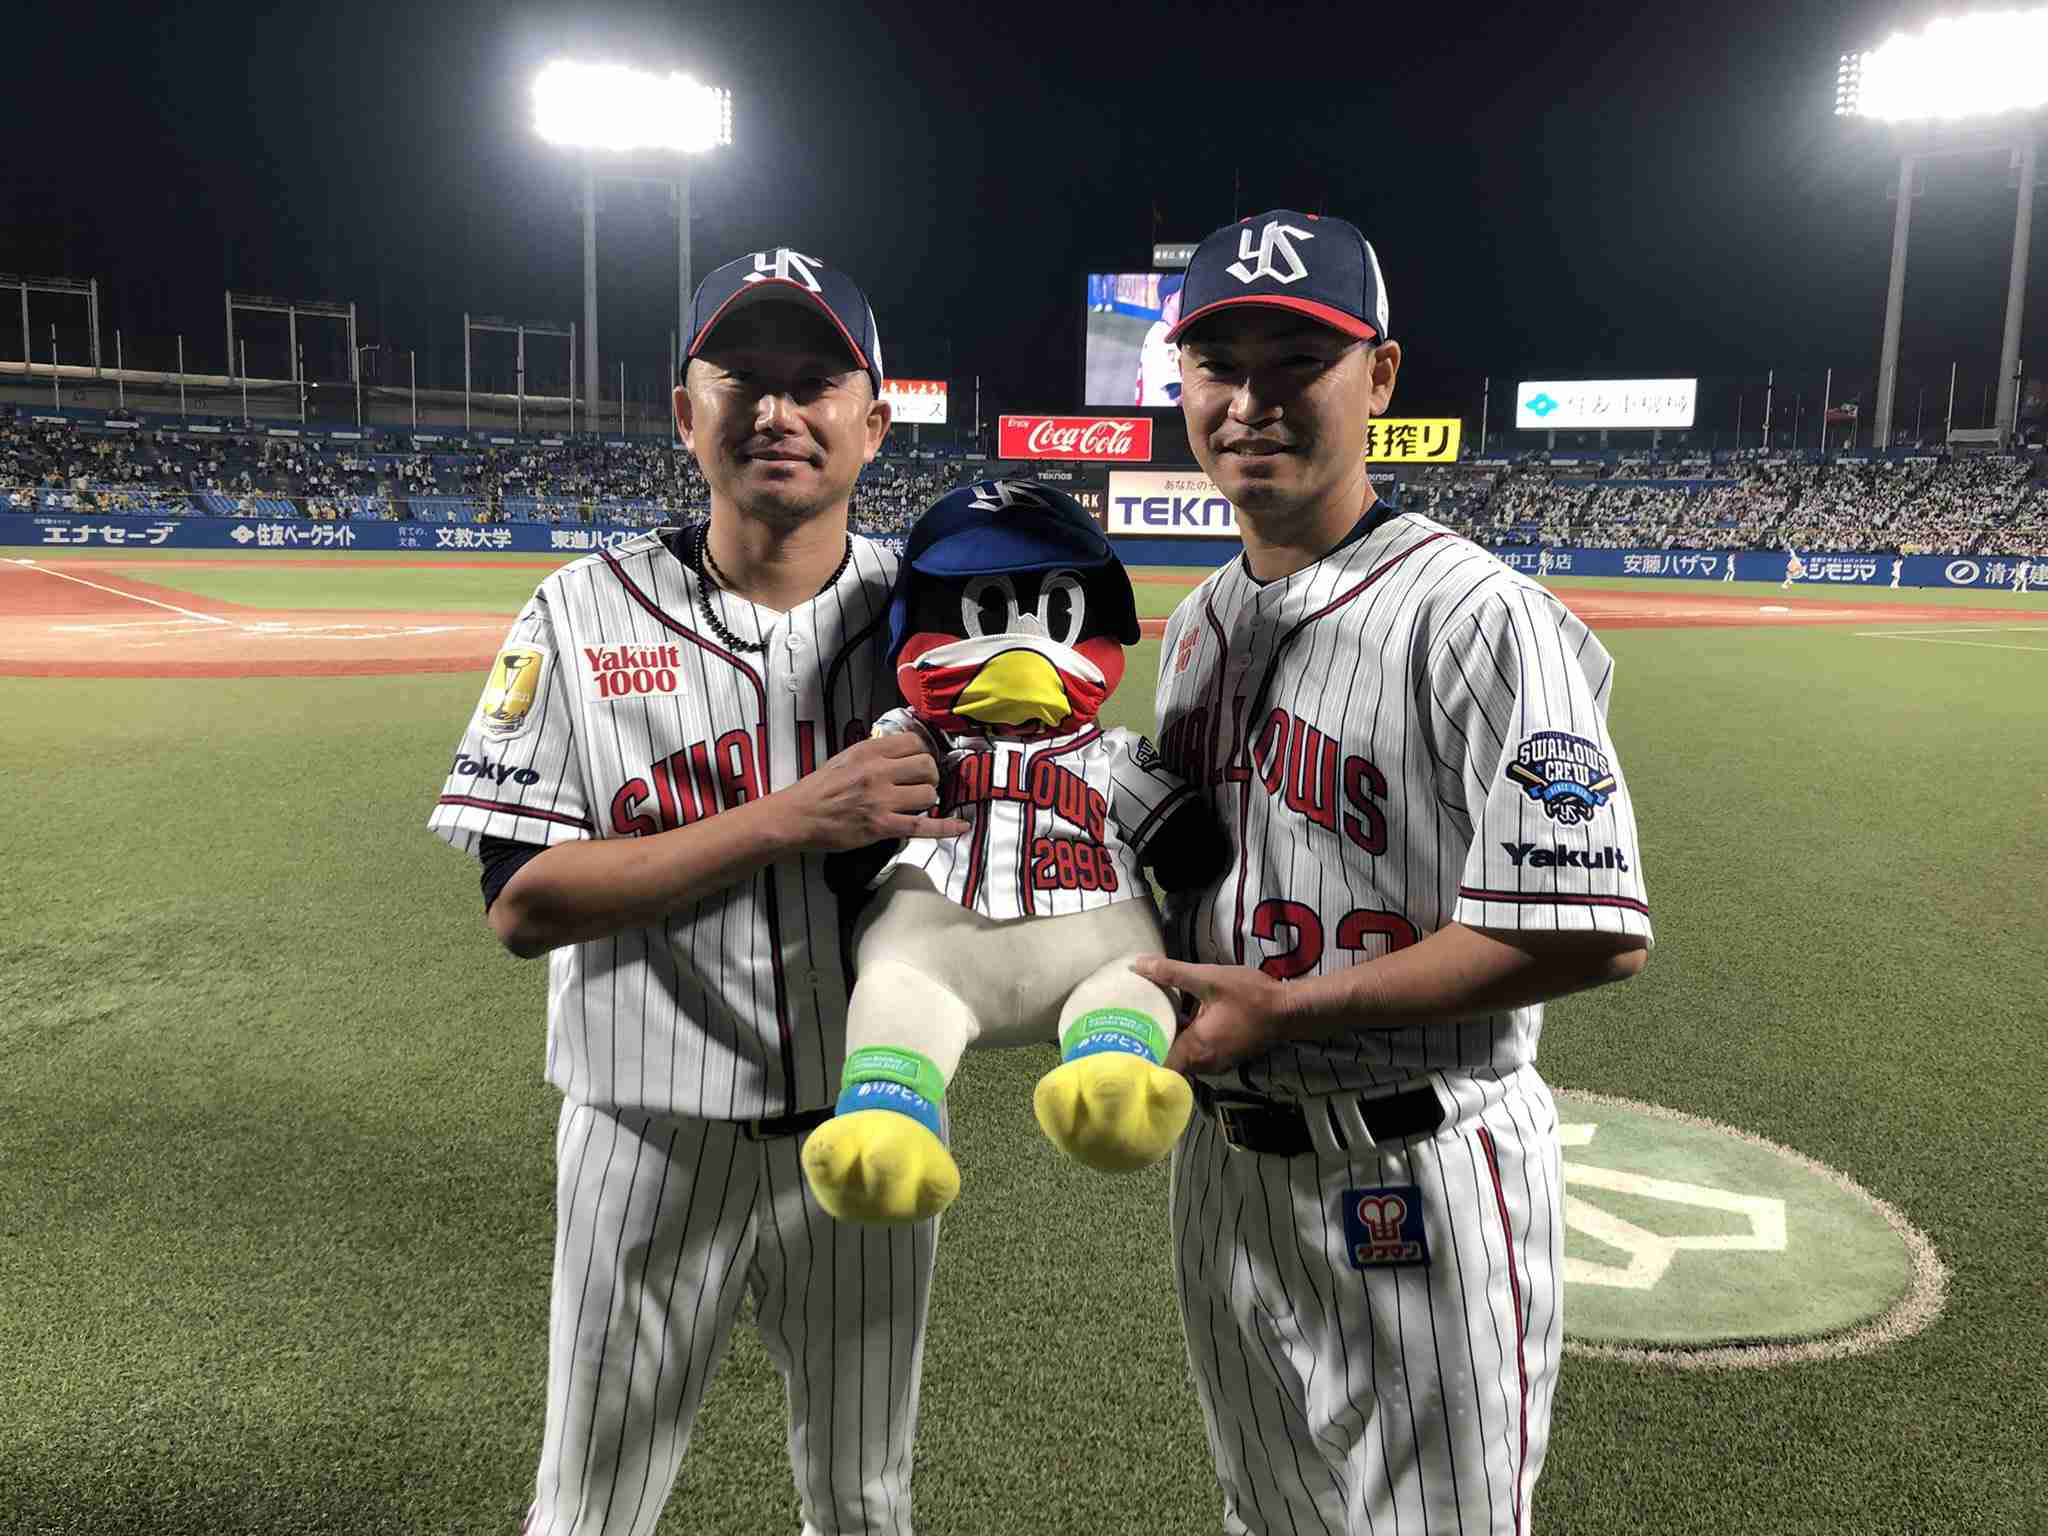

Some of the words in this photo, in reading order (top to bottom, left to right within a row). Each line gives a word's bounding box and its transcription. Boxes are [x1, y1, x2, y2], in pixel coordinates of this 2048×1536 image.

[1115, 497, 1238, 526] TEKN
[43, 524, 174, 545] エナセーブ
[257, 522, 356, 547] 住友ベークライト
[435, 527, 512, 548] 文教大学
[1624, 554, 1717, 576] 安藤ハザマ
[1808, 562, 1877, 581] シモジマ
[583, 645, 681, 672] Yakult
[593, 669, 677, 698] 1000
[450, 754, 540, 786] Tokyo
[1519, 737, 1609, 777] SWALLOWS
[1545, 760, 1590, 786] CREW
[1033, 837, 1119, 892] 2896
[1501, 842, 1629, 874] Yakult
